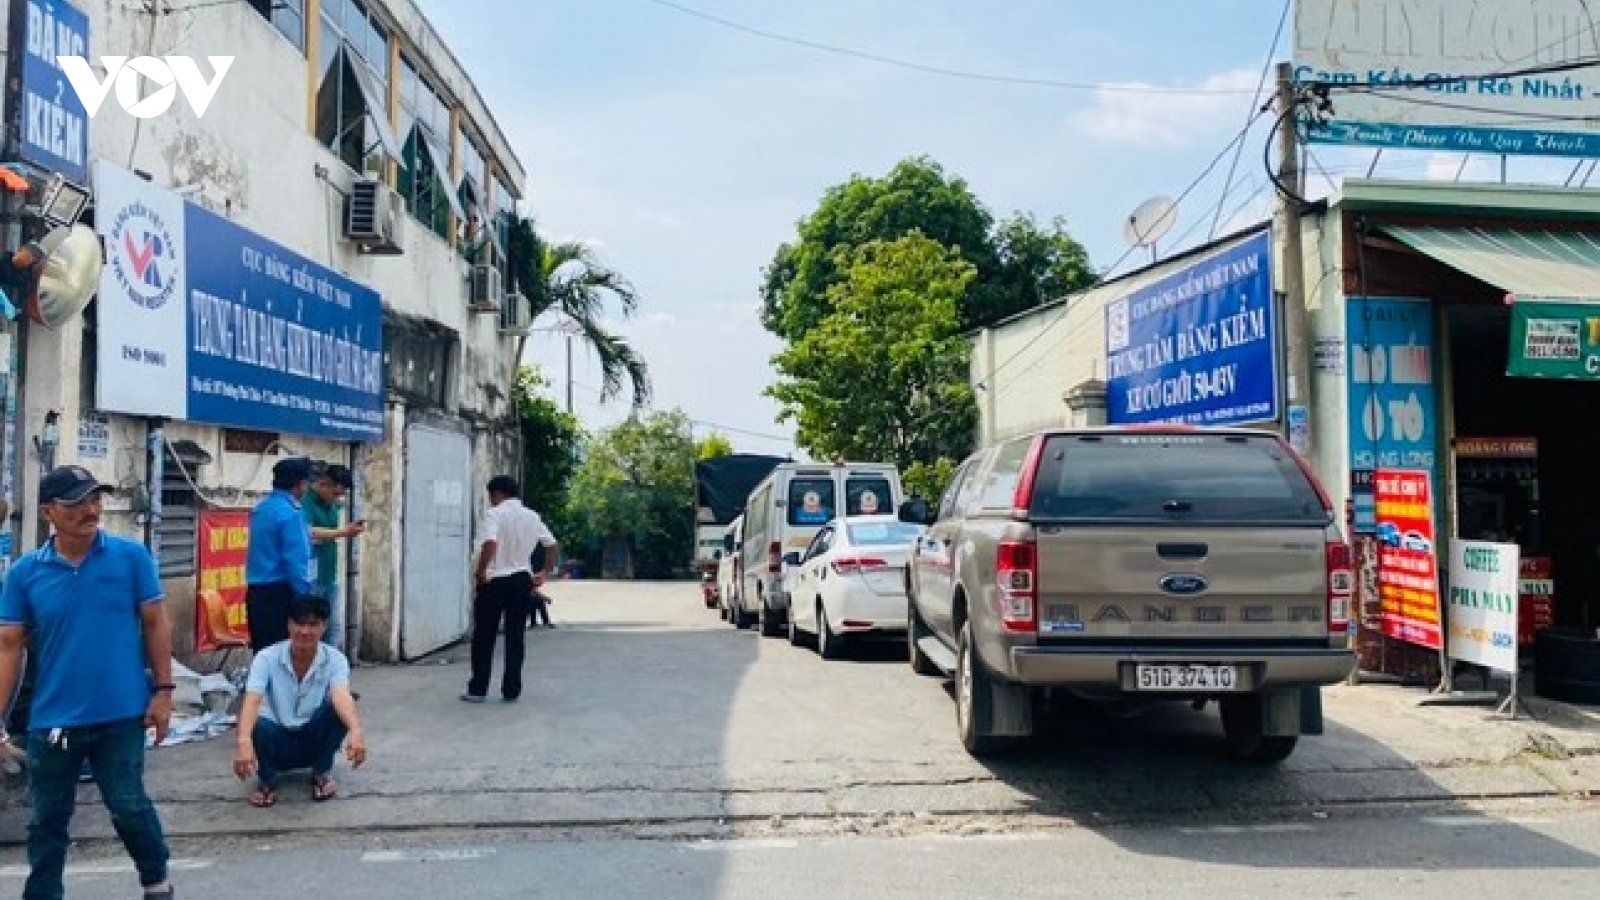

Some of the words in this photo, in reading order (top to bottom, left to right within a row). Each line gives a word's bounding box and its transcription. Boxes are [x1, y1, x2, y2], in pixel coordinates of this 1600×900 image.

[27, 79, 82, 166] KIỂM
[1231, 253, 1259, 277] NAM
[1145, 334, 1174, 369] TÂM
[1177, 324, 1219, 361] ĐĂNG
[1220, 293, 1266, 349] KIỂM
[1044, 603, 1322, 622] RANGER
